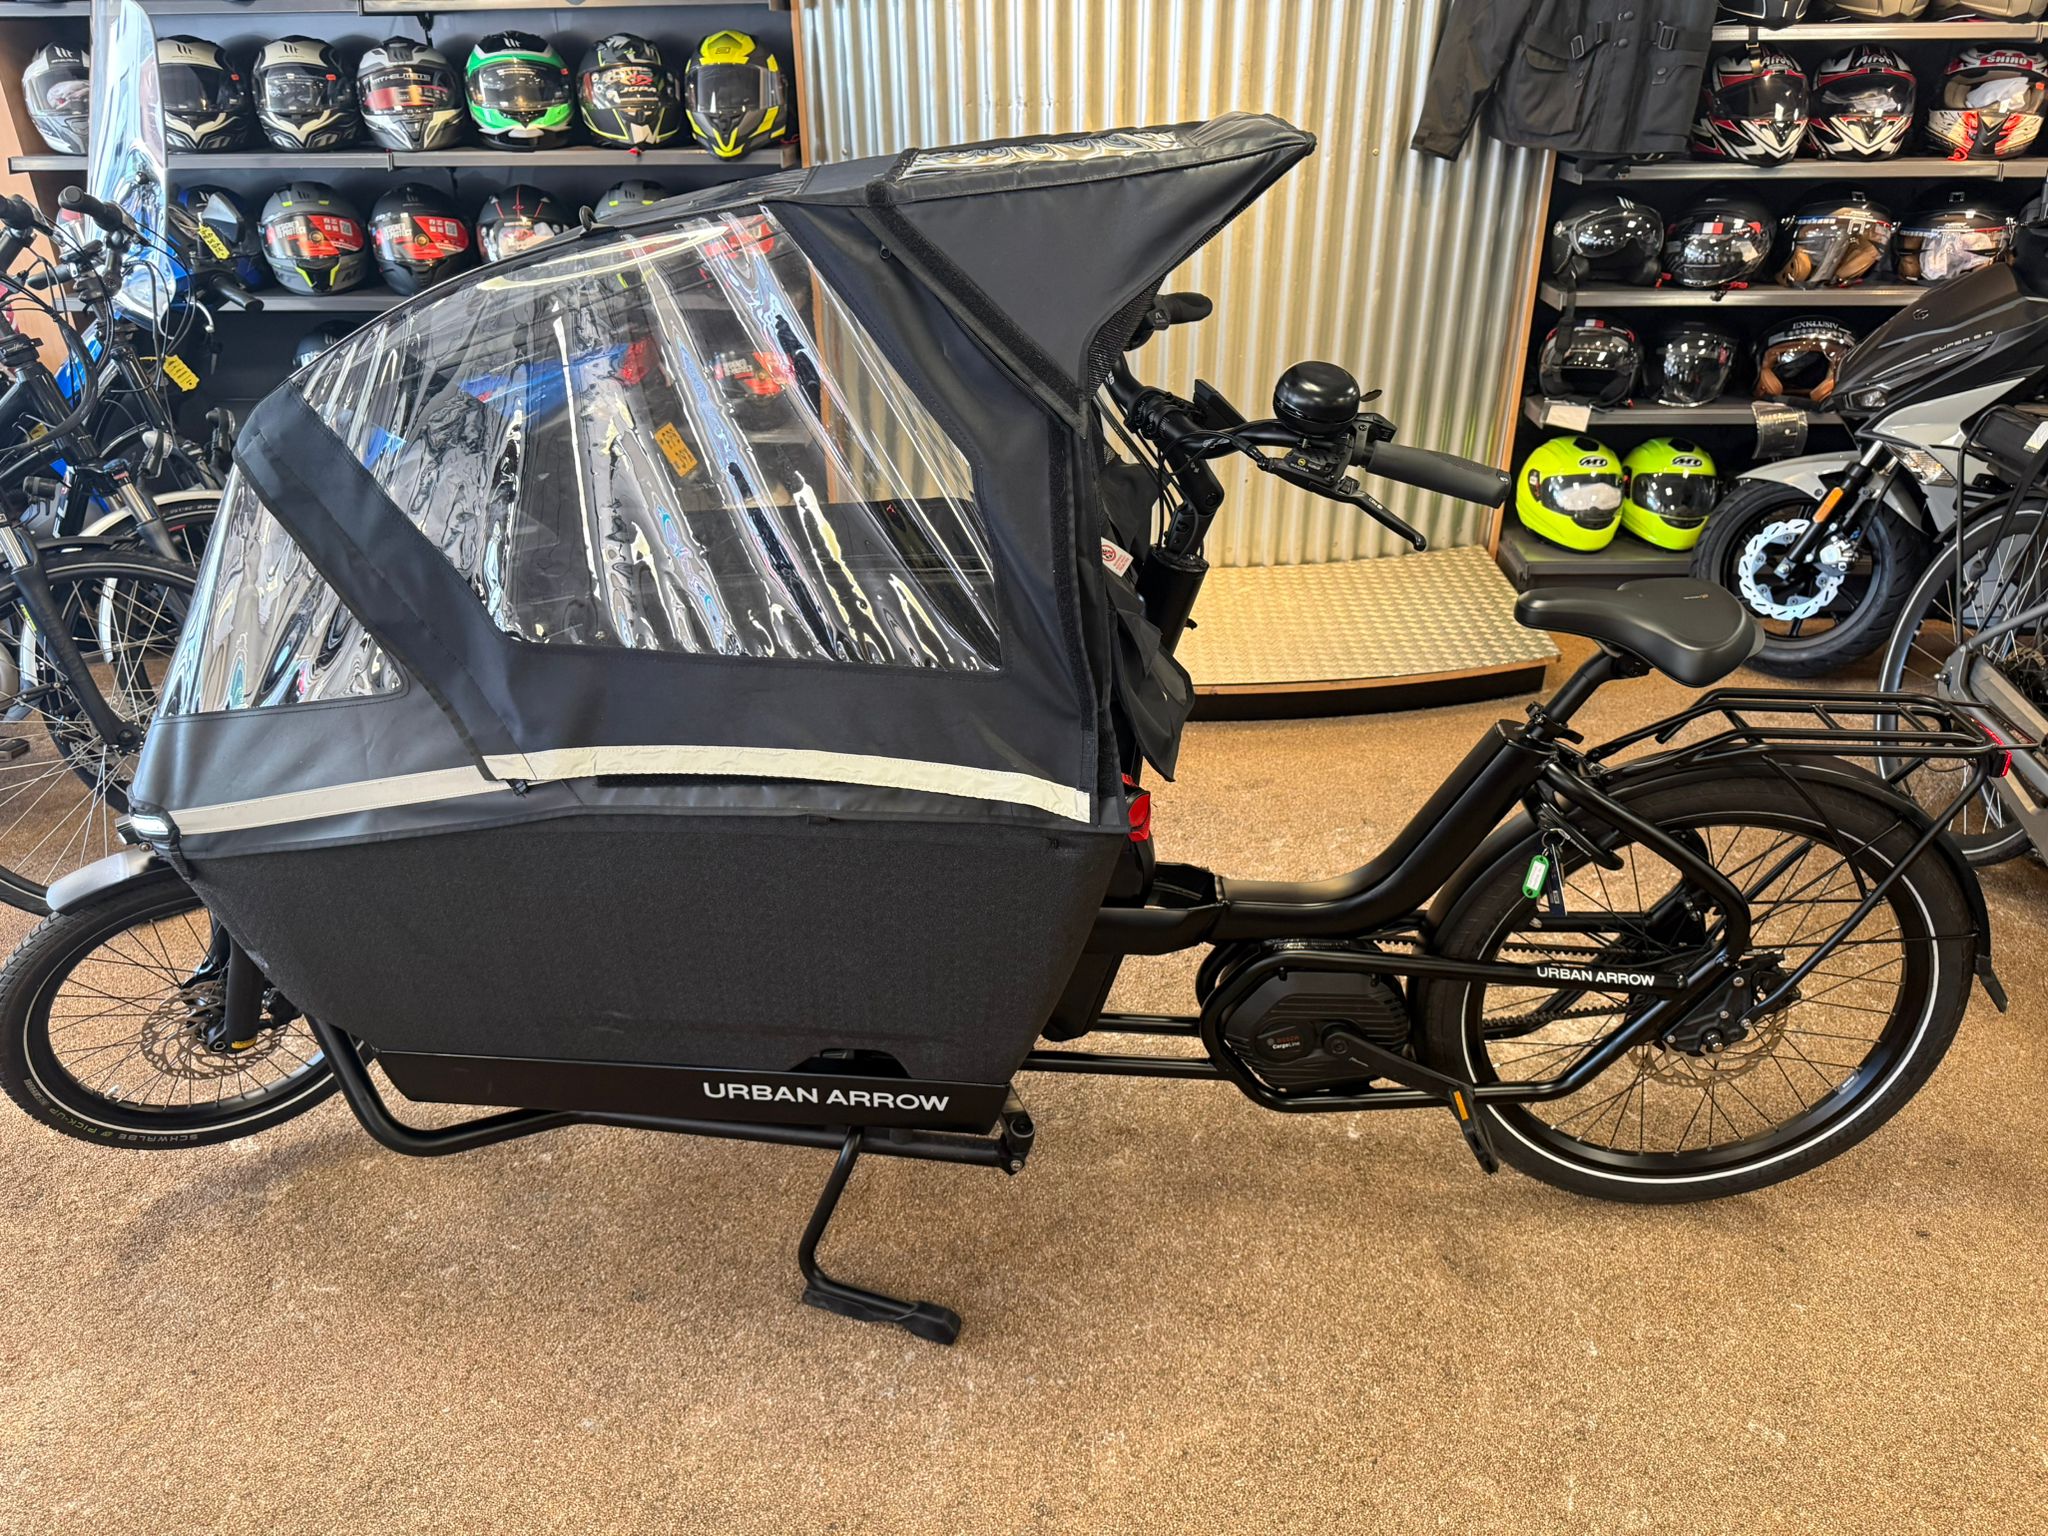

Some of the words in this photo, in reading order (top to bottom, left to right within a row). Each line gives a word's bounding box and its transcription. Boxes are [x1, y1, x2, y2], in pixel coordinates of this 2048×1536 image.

[1856, 55, 1894, 67] Airoh
[1986, 55, 2028, 66] SHIRO
[1792, 320, 1839, 330] EXKLUSIV
[1931, 337, 1970, 354] SUPER
[1536, 966, 1593, 982] URBAN
[1595, 970, 1656, 987] ARROW
[702, 1081, 819, 1104] URBAN
[825, 1089, 950, 1112] ARROW
[117, 1133, 199, 1142] SCHWALBE
